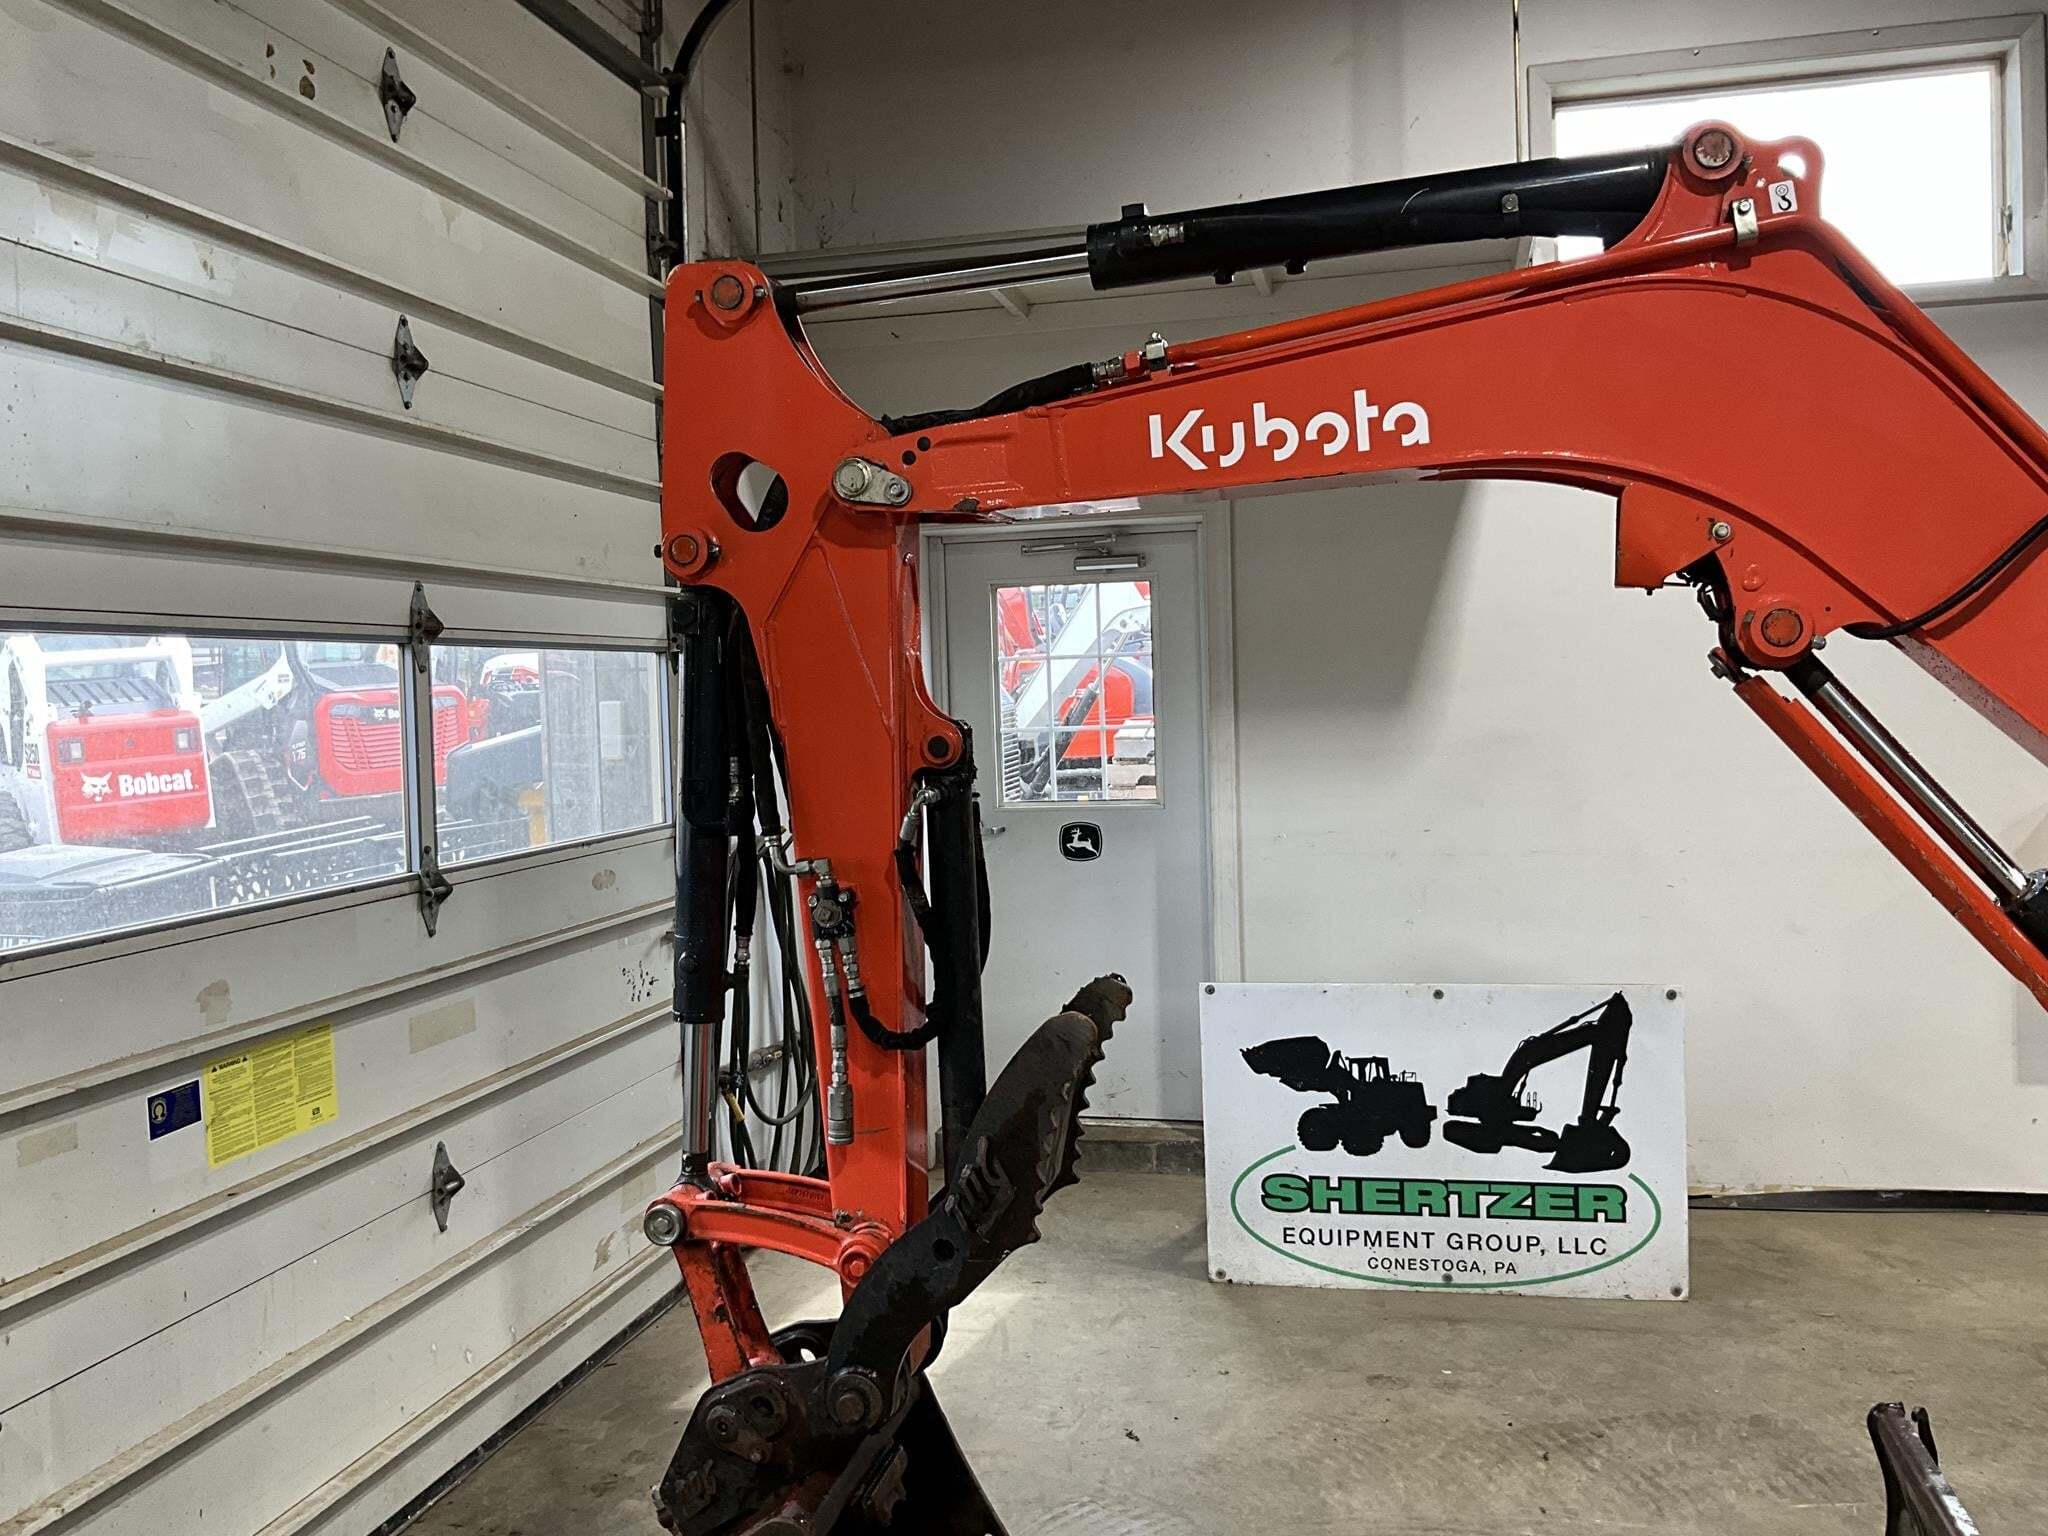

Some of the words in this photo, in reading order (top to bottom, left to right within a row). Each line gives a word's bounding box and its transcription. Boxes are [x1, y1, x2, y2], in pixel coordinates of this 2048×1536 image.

[1149, 389, 1431, 471] Kubota
[118, 768, 193, 797] Bobcat
[1261, 1173, 1628, 1223] SHERTZER
[1283, 1227, 1435, 1249] EQUIPMENT
[1446, 1232, 1545, 1256] GROUP,
[1558, 1236, 1607, 1256] LLC
[1368, 1256, 1486, 1275] CONESTOGA,
[1494, 1261, 1517, 1274] PA
